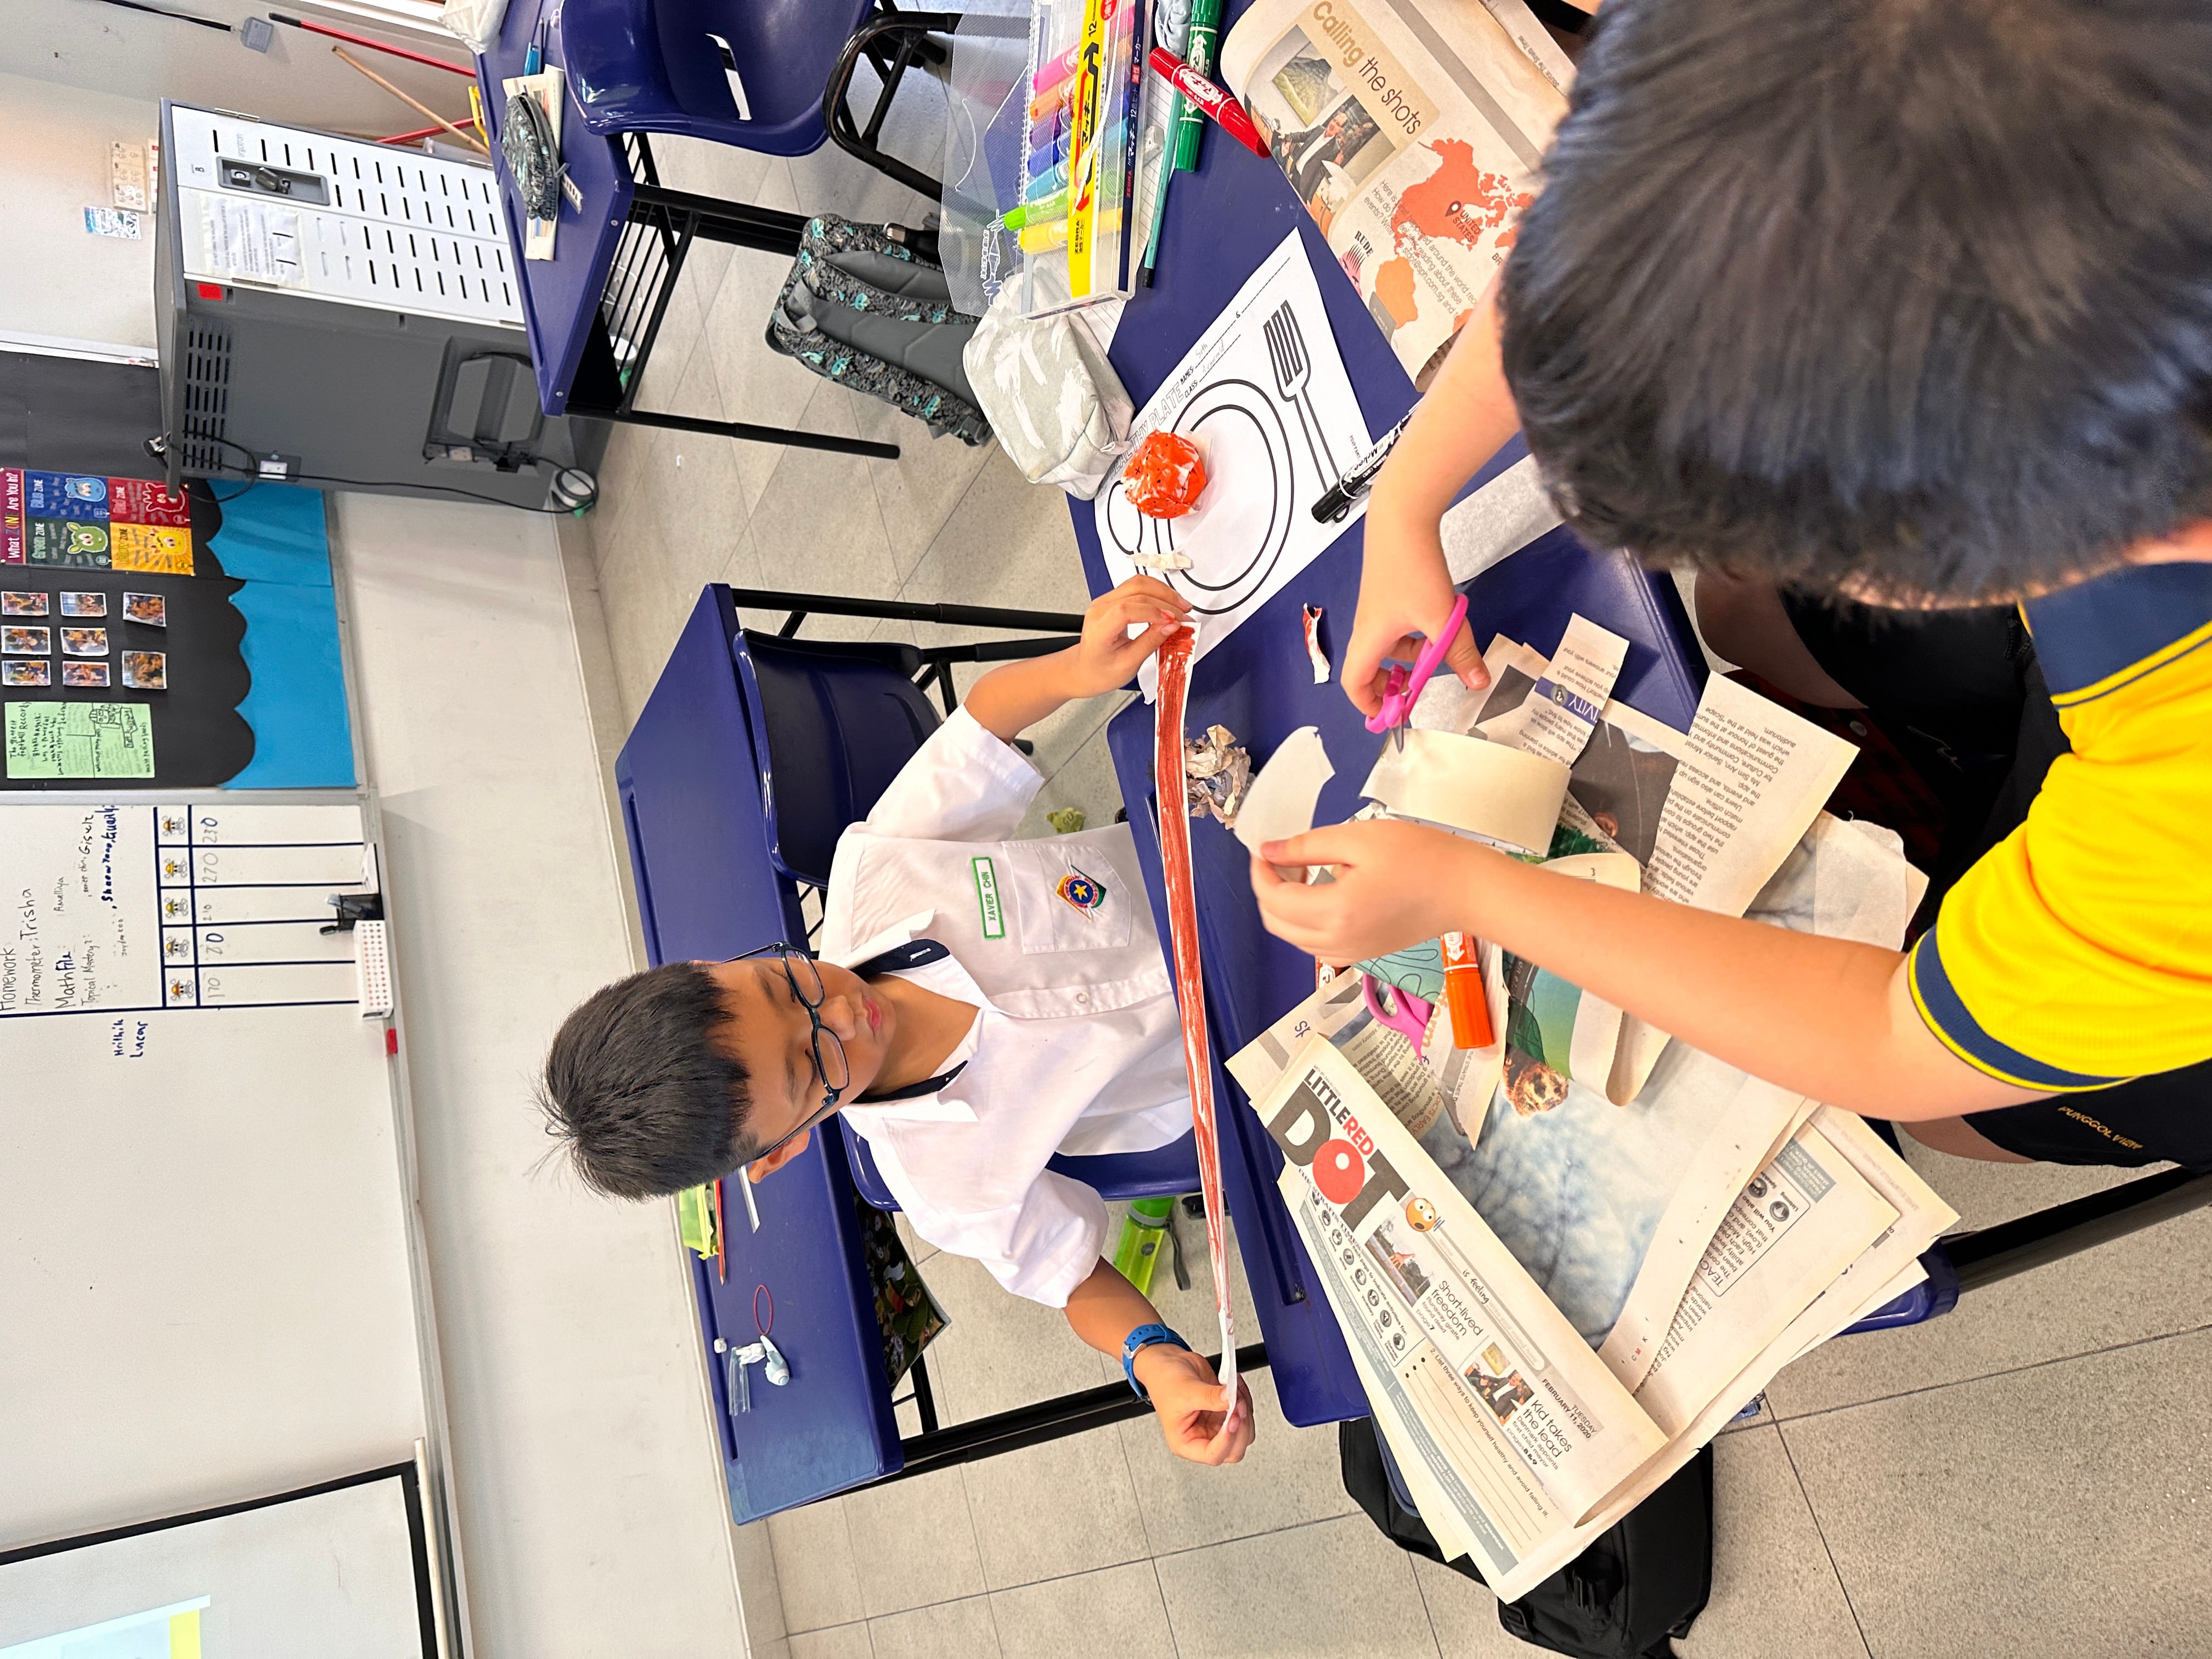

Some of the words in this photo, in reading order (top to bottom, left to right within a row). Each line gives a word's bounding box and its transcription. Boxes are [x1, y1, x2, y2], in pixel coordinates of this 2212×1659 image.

[1088, 20, 1097, 37] 12
[1313, 1, 1364, 67] Calling
[1359, 57, 1385, 91] the
[1381, 89, 1420, 134] shots
[1453, 217, 1474, 242] STATES
[1460, 210, 1481, 235] UNITED
[1355, 231, 1373, 257] RUDE
[1372, 188, 1384, 203] How
[1383, 202, 1393, 212] do
[1415, 247, 1435, 271] reading
[1434, 269, 1449, 287] about
[1447, 286, 1462, 304] these
[1429, 245, 1448, 267] around
[1444, 263, 1458, 278] the
[1454, 275, 1469, 293] world
[1443, 301, 1457, 314] and
[5, 471, 19, 483] In?
[5, 483, 19, 496] You
[6, 496, 19, 511] Are
[3, 511, 20, 535] ZONE
[7, 536, 21, 559] What
[1693, 734, 1706, 743] and
[1728, 731, 1749, 746] honour
[1764, 727, 1796, 748] auditorium.
[1703, 751, 1723, 765] Senior
[1706, 741, 1739, 763] Community
[1730, 743, 1778, 774] Communications
[1725, 761, 1737, 773] Ann,
[1738, 770, 1750, 781] Sim
[1742, 760, 1763, 776] Culture,
[1748, 776, 1761, 787] Ms
[1696, 805, 1715, 819] before
[1723, 809, 1743, 825] match
[1683, 819, 1703, 833] groups
[1692, 814, 1730, 838] communicate
[1714, 816, 1737, 831] rapport
[1661, 827, 1690, 849] interested
[1703, 831, 1714, 841] two
[1713, 837, 1725, 848] the
[1669, 844, 1708, 872] organisations.
[1689, 845, 1705, 860] Those
[980, 871, 991, 889] CHIN
[985, 894, 996, 921] XAVIER
[0, 948, 16, 1011] Homework
[1414, 1072, 1425, 1082] Day
[1408, 1115, 1431, 1136] EARLY
[2058, 1107, 2111, 1137] PUNGGOL
[1265, 1081, 1411, 1233] DOT
[1742, 1196, 1754, 1209] also
[1780, 1192, 1798, 1211] Listening
[1732, 1217, 1745, 1229] and
[1752, 1207, 1765, 1222] will
[1762, 1217, 1777, 1233] You
[1730, 1238, 1744, 1255] Each
[1738, 1235, 1757, 1255] High,
[1746, 1229, 1762, 1248] (Low),
[1726, 1248, 1743, 1265] ability
[1461, 1268, 1471, 1278] is
[1466, 1276, 1493, 1306] feeling
[1422, 1302, 1435, 1318] found
[1435, 1319, 1446, 1333] dead
[1426, 1296, 1446, 1322] Runaway
[1445, 1323, 1459, 1340] giraffe
[1431, 1290, 1466, 1336] freedom
[1439, 1281, 1483, 1336] Short-lived
[1433, 1353, 1446, 1367] List
[1441, 1364, 1456, 1383] three
[1454, 1381, 1465, 1396] ways
[1462, 1395, 1471, 1404] to
[1542, 1379, 1571, 1412] FEBRUARY
[1567, 1412, 1580, 1425] 11,
[1577, 1423, 1591, 1438] 2020
[1465, 1402, 1481, 1420] keep
[1572, 1404, 1597, 1435] TUESDAY
[1476, 1419, 1494, 1441] yourself
[1520, 1407, 1542, 1431] the
[1538, 1429, 1562, 1457] lead
[1531, 1400, 1549, 1420] Kid
[1546, 1419, 1571, 1452] takes
[1492, 1441, 1508, 1463] healthy
[1513, 1421, 1522, 1433] first
[1522, 1434, 1534, 1448] child
[1533, 1449, 1548, 1467] mayor
[1517, 1416, 1538, 1443] Denmark
[1538, 1444, 1558, 1470] appoints
[1508, 1464, 1517, 1475] and
[1516, 1476, 1530, 1492] avoid
[1529, 1492, 1543, 1510] falling
